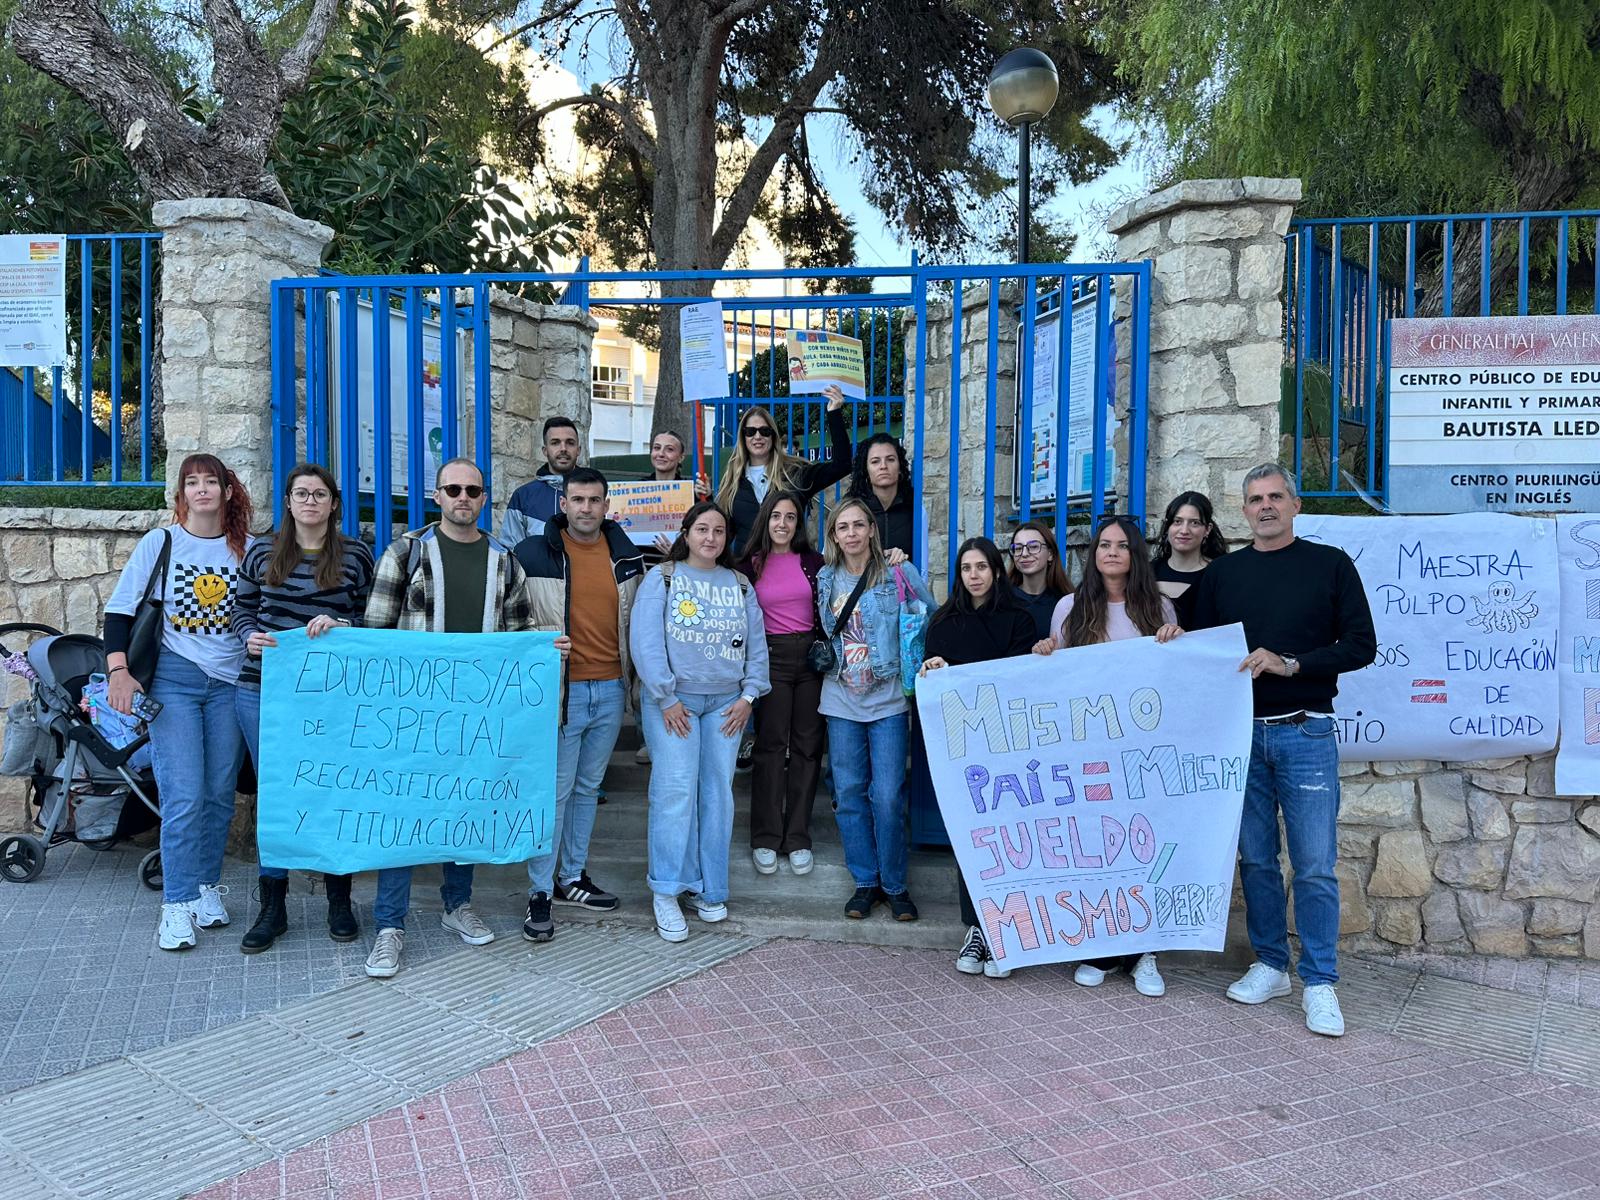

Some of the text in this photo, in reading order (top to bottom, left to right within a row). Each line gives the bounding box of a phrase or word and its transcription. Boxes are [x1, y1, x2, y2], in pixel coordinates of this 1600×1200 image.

[1430, 332, 1536, 350] GENERALITAT
[1400, 369, 1600, 386] CENTRO PÚBLICO DE EDU
[1442, 395, 1600, 410] INFANTIL Y PRIMAR
[1443, 420, 1600, 438] BAUTISTA LLED
[632, 484, 671, 494] NECESITAN
[1451, 470, 1600, 487] CENTRO PLURILINGÜ
[628, 496, 662, 506] ATENCIÓN
[1486, 489, 1572, 504] EN INGLÉS
[643, 505, 654, 513] NO
[656, 503, 686, 513] LLEGO
[1398, 540, 1533, 580] MAESTRA
[693, 580, 744, 609] MAGI
[1376, 584, 1466, 616] PULPO
[709, 608, 727, 618] OF
[666, 622, 723, 644] STATE OF
[720, 644, 746, 661] MIN
[1446, 628, 1559, 672] EDUCACIÓN
[295, 651, 546, 708] EDUCADORES/AS
[1483, 686, 1510, 704] DE
[303, 704, 522, 758] DE ESPECIAL
[941, 683, 1162, 760] MISMO
[1449, 714, 1544, 737] CALIDAD
[293, 760, 520, 801] RECLASIFICACIÓN
[1121, 745, 1248, 799] MISM
[295, 810, 308, 836] Y
[334, 809, 485, 849] TITULACIÓN
[979, 884, 1152, 960] MISMOS
